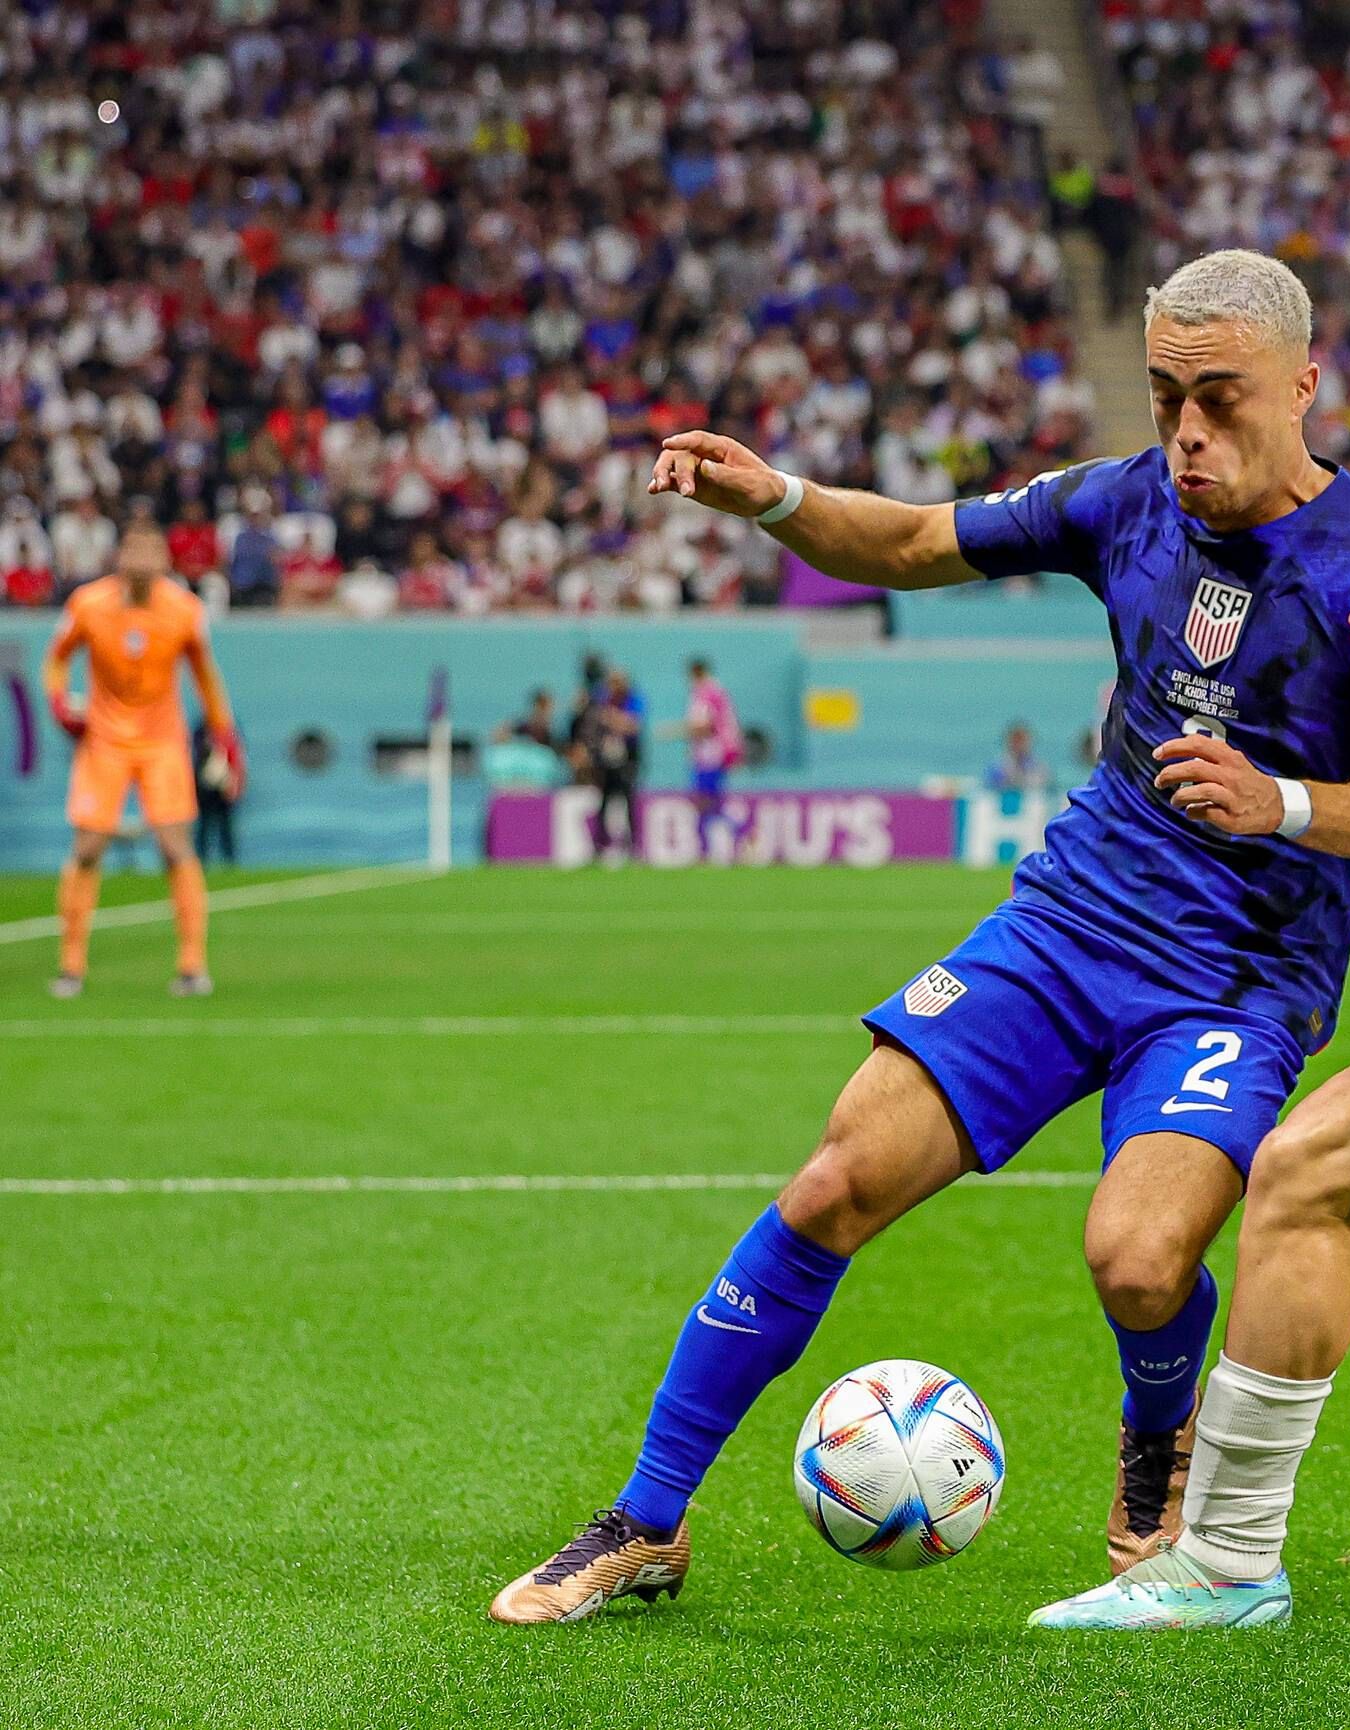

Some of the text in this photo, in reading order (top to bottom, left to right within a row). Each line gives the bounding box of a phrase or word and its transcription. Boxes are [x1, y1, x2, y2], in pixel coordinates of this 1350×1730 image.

[1199, 582, 1248, 620] USA
[1171, 669, 1209, 689] ENGLAND
[1220, 684, 1236, 698] USA
[1166, 690, 1239, 720] 25 NOVEMBER 2022
[1209, 692, 1233, 708] QATAR
[927, 968, 962, 998] USA
[1180, 1029, 1243, 1100] 2
[716, 1276, 757, 1316] USA
